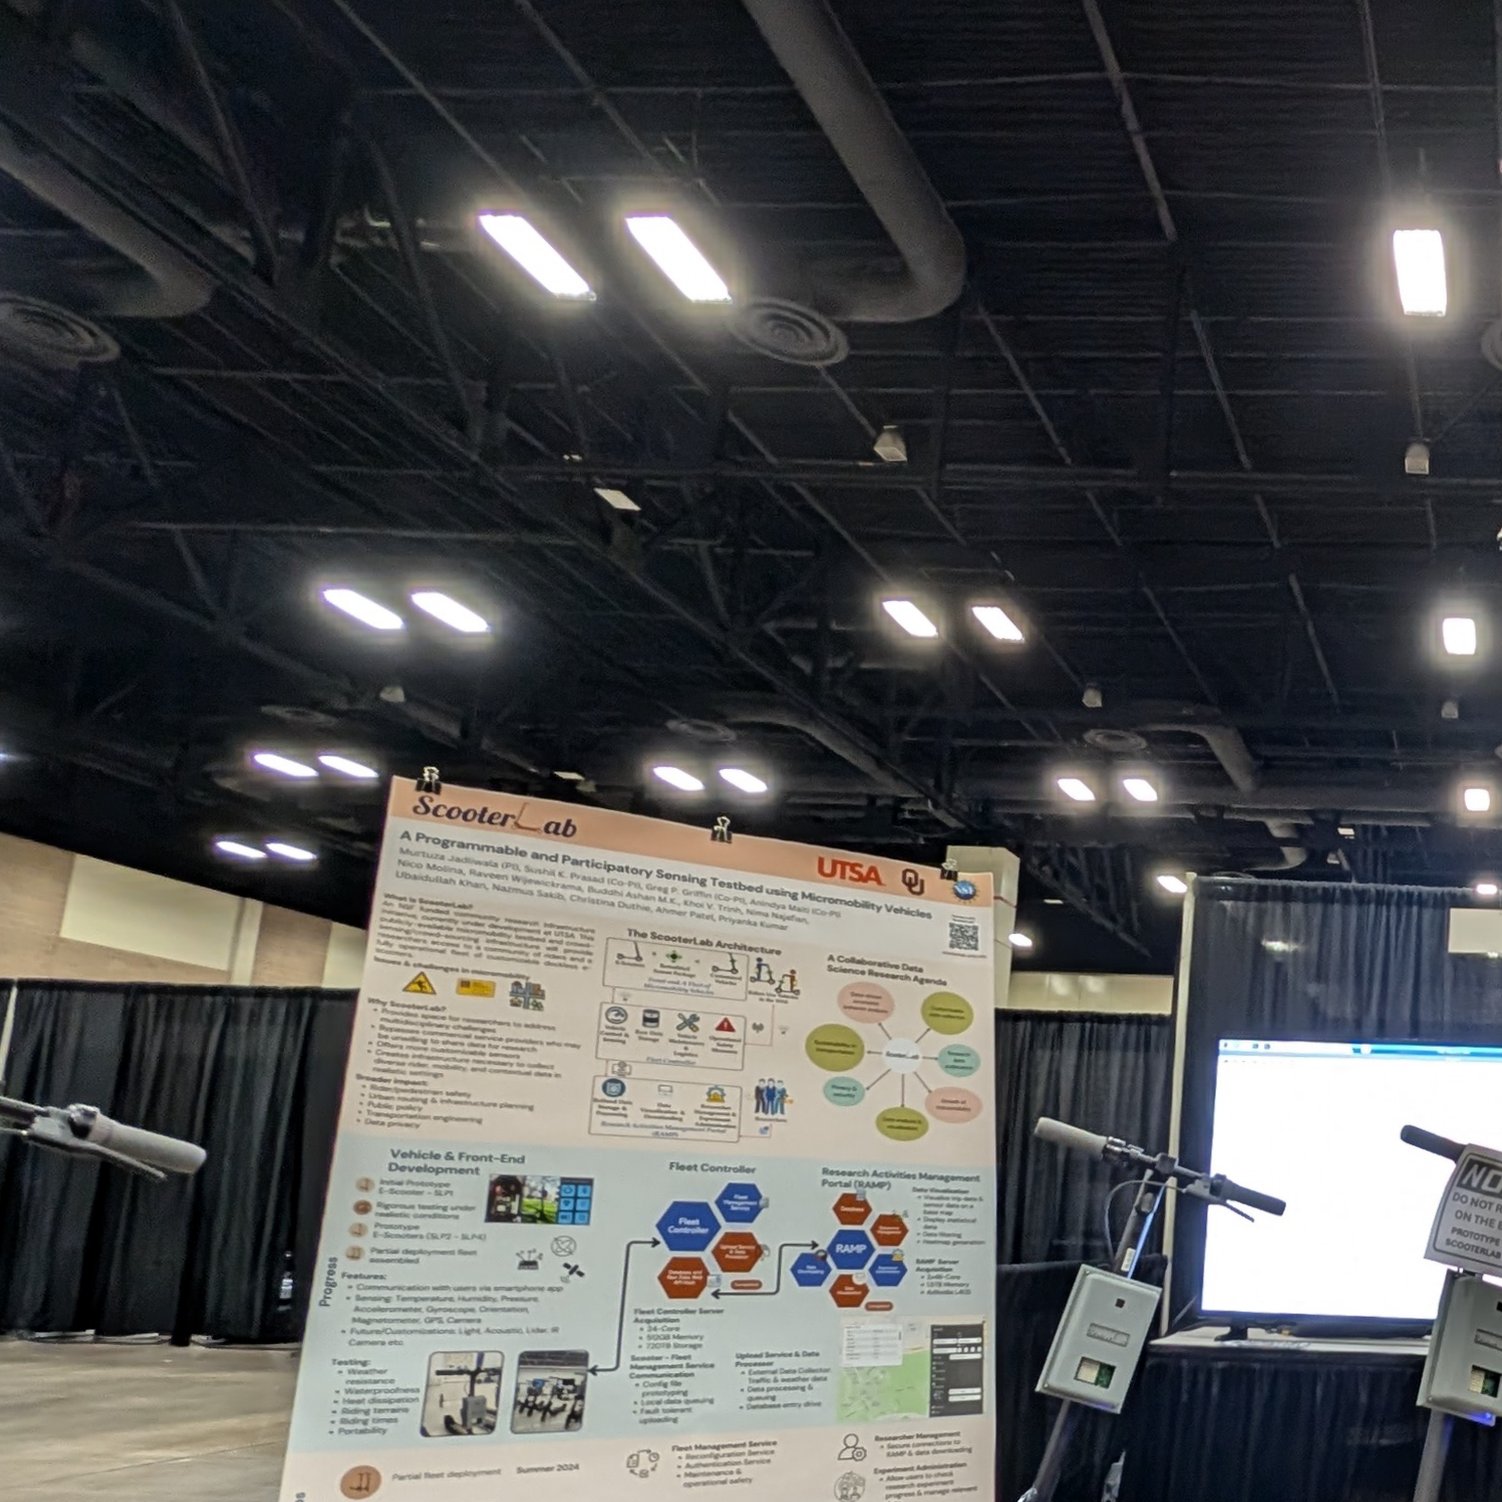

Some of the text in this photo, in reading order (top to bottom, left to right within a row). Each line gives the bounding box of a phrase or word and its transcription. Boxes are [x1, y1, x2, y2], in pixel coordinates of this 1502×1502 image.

[400, 829, 412, 841] A
[415, 832, 528, 857] Programmable
[530, 851, 559, 863] and
[561, 854, 653, 877] Participatory
[656, 868, 708, 887] Sensing
[710, 876, 764, 893] Testbed
[765, 887, 799, 901] using
[801, 891, 883, 911] Micromobility
[884, 903, 933, 919] Vehicles
[817, 856, 886, 887] UTSA
[627, 927, 782, 955] The ScooterLab Architecture
[827, 953, 924, 973] A Collaborative Data
[827, 964, 948, 986] Science Research Agenda
[390, 1148, 526, 1164] Vehicle & Front-End
[388, 1161, 481, 1175] Development
[669, 1161, 757, 1174] Fleet Controller
[822, 1166, 981, 1182] Research Activities Management
[821, 1178, 892, 1190] Portal (RAMP)
[1453, 1192, 1468, 1205] DO
[1470, 1194, 1494, 1211] NOT
[676, 1216, 701, 1225] Fleet
[1455, 1209, 1472, 1222] ON
[1474, 1214, 1496, 1229] THE
[667, 1225, 709, 1234] Controller
[1451, 1227, 1500, 1246] PROTOTYPE
[835, 1243, 867, 1254] RAMP
[1446, 1238, 1501, 1259] SCOOTERLAB
[318, 1256, 338, 1308] Progress
